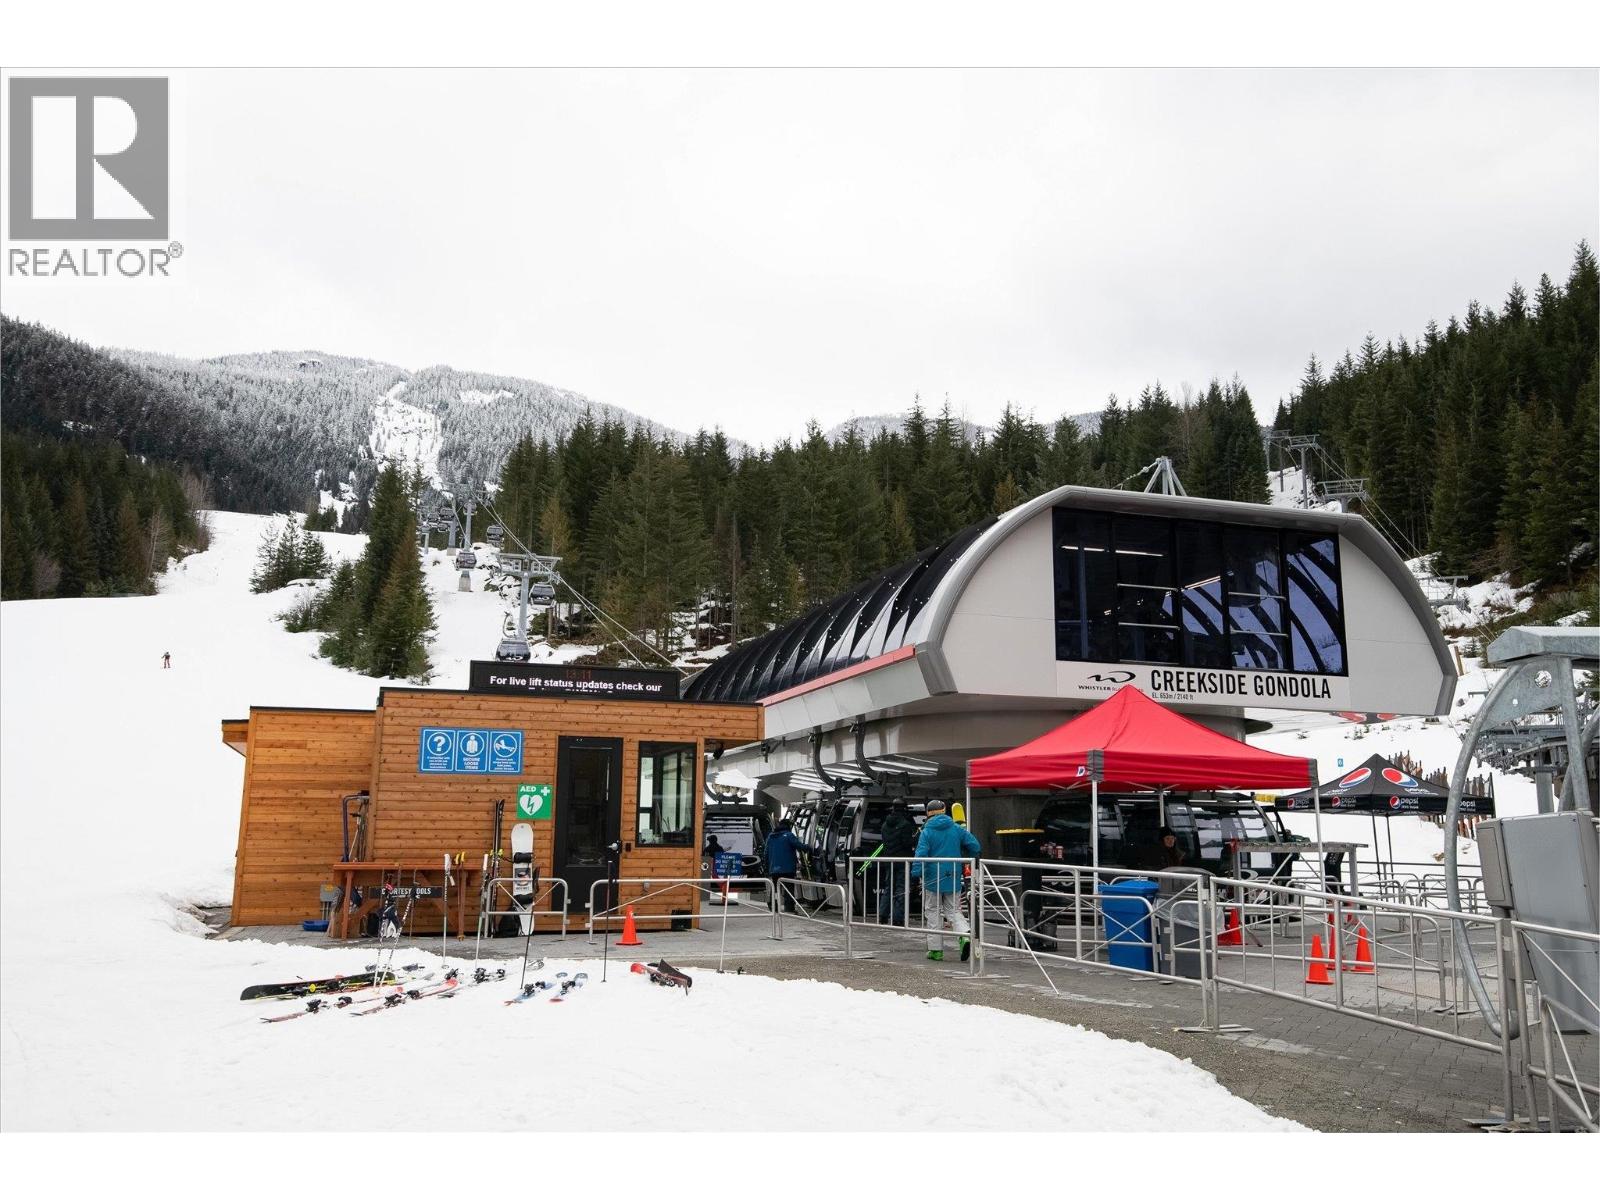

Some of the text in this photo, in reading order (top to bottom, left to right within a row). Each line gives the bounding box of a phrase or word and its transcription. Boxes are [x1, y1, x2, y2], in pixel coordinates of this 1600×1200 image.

[490, 676, 506, 685] For
[509, 676, 526, 686] live
[529, 677, 542, 687] lift
[544, 679, 574, 689] status
[576, 681, 614, 691] updates
[616, 683, 645, 692] check
[1151, 670, 1331, 699] CREEKSIDE GONDOLA
[1401, 798, 1419, 806] pepsi
[414, 887, 432, 895] OOLS
